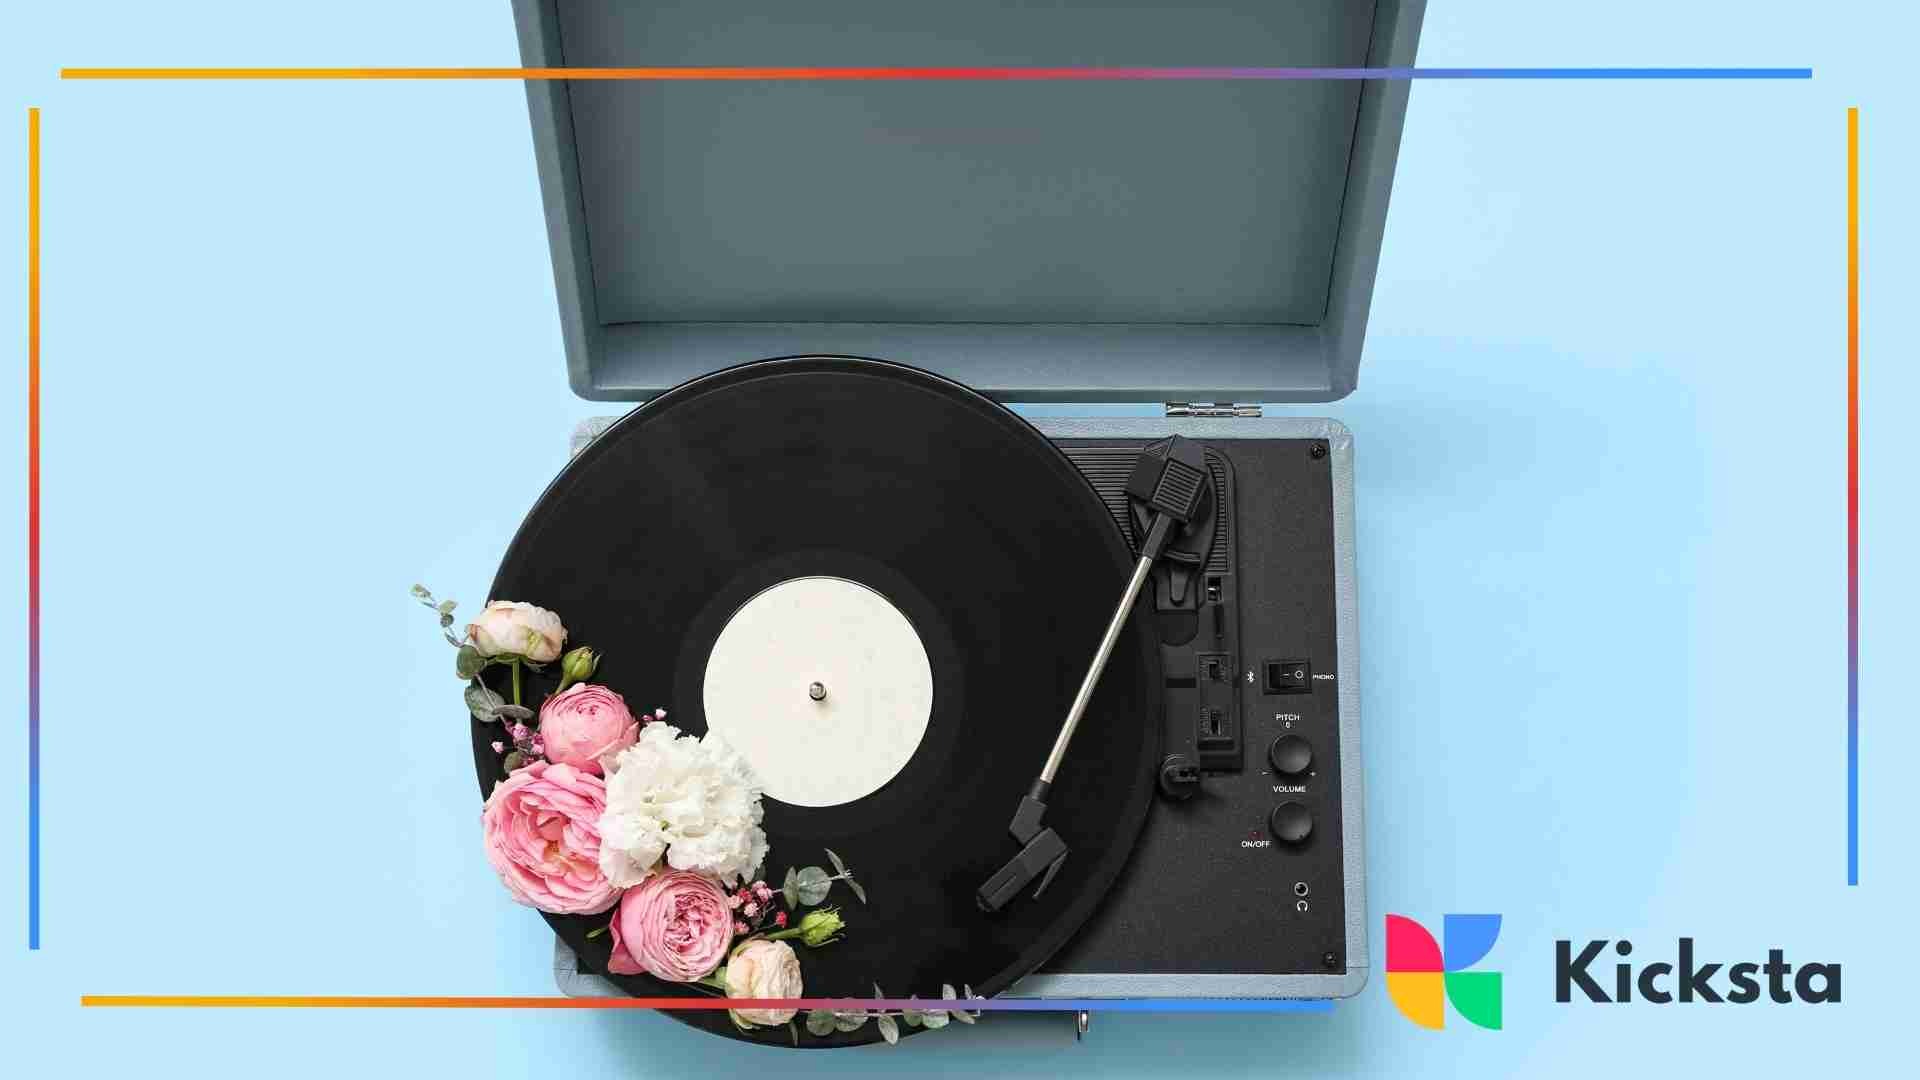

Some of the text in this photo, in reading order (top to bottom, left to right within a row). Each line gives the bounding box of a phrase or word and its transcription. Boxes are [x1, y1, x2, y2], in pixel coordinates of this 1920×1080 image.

[1275, 713, 1300, 721] PITCH
[1272, 785, 1306, 793] VOLUME
[1241, 840, 1270, 848] ON/OFF
